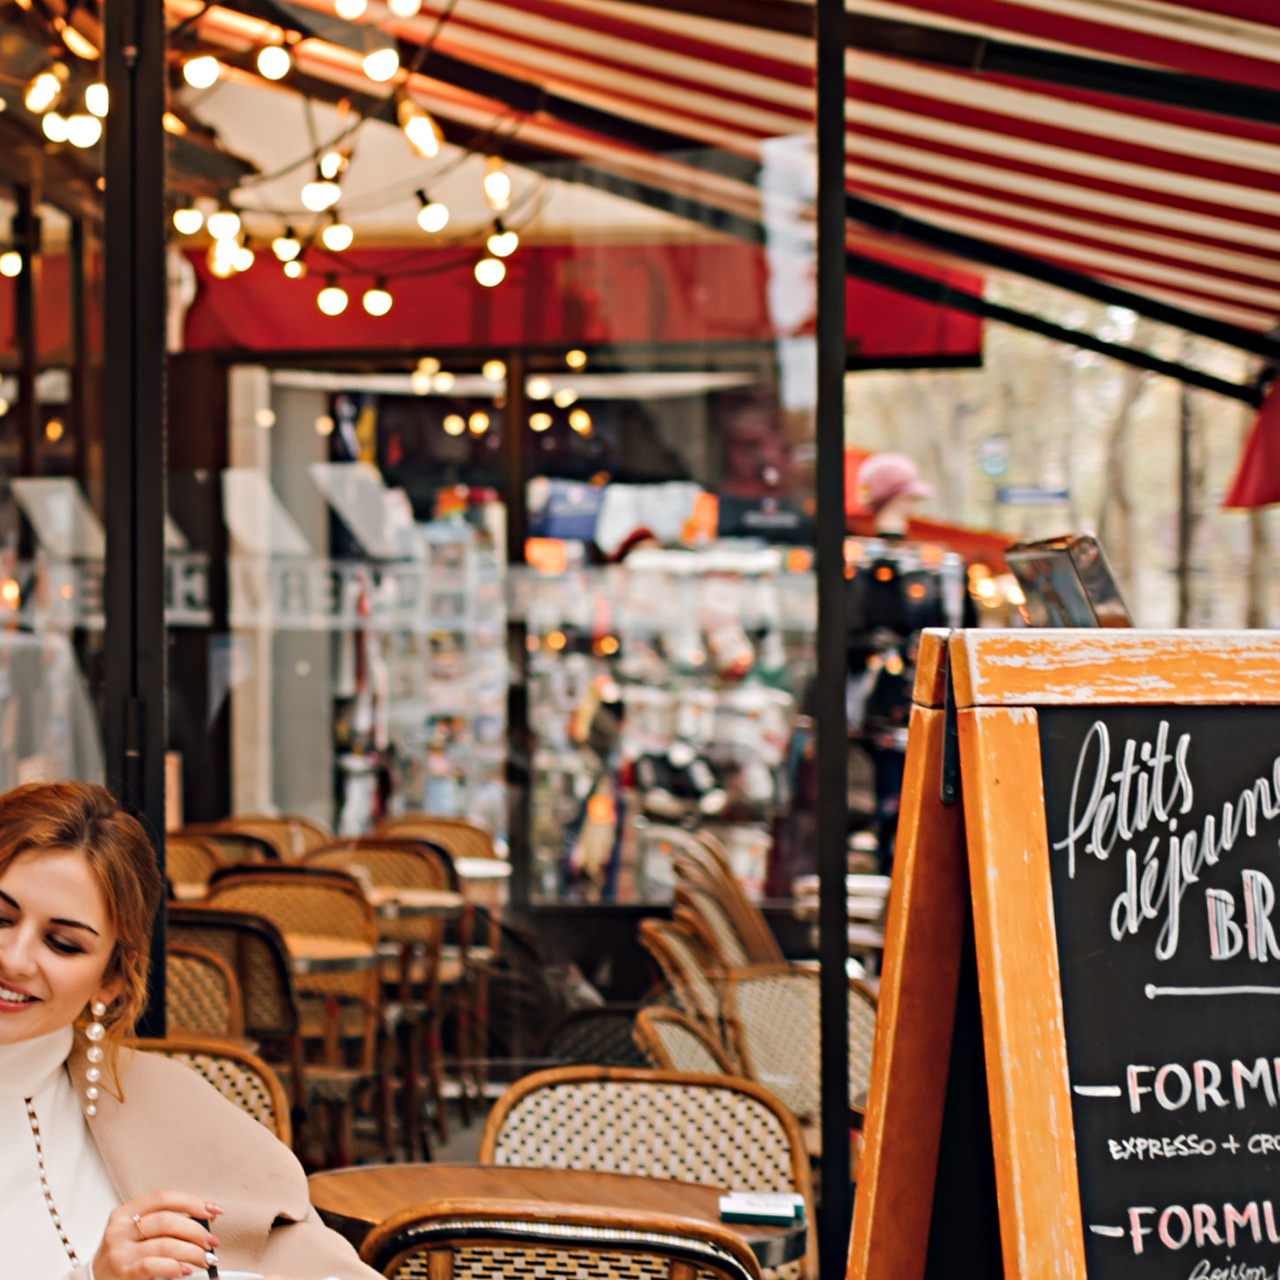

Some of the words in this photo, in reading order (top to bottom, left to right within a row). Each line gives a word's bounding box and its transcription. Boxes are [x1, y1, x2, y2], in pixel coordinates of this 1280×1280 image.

[1053, 720, 1193, 879] Petits
[1110, 756, 1280, 961] déjeun
[1126, 1057, 1280, 1114] FORM
[1107, 1133, 1217, 1161] EXPRESSO
